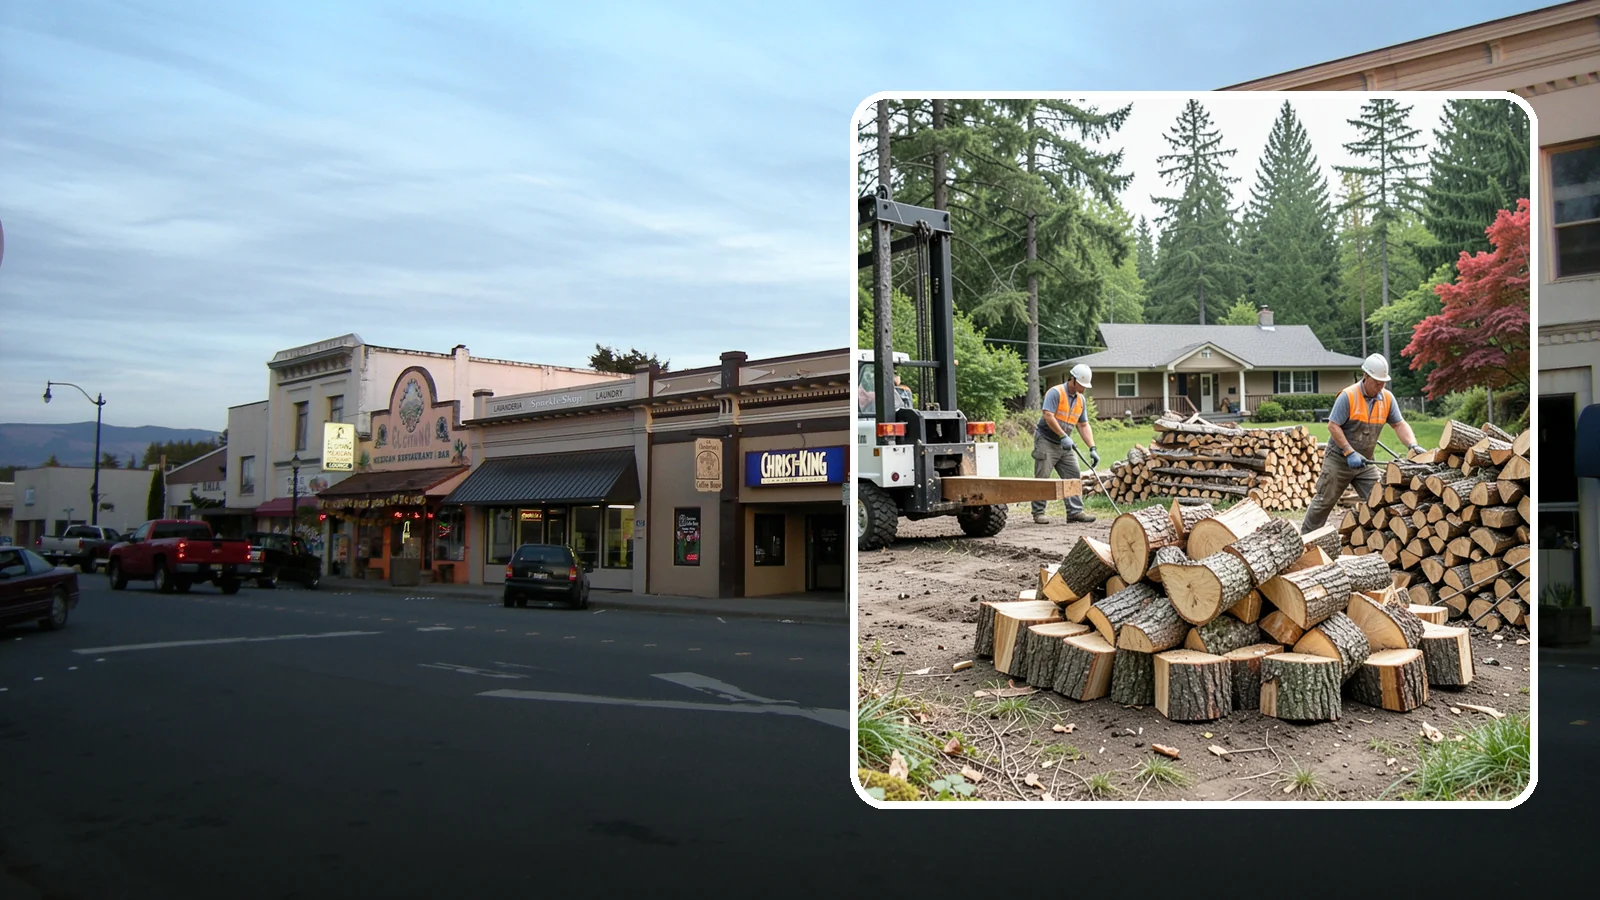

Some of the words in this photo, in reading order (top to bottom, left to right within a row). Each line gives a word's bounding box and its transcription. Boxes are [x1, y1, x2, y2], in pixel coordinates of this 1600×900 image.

[493, 402, 522, 413] LAVANDERIA
[562, 394, 582, 405] Shop
[595, 388, 623, 400] LAUNDRY
[373, 454, 396, 464] MEXICAN
[397, 451, 433, 463] RESTAURANT
[438, 450, 450, 459] BAR
[799, 450, 827, 476] KING
